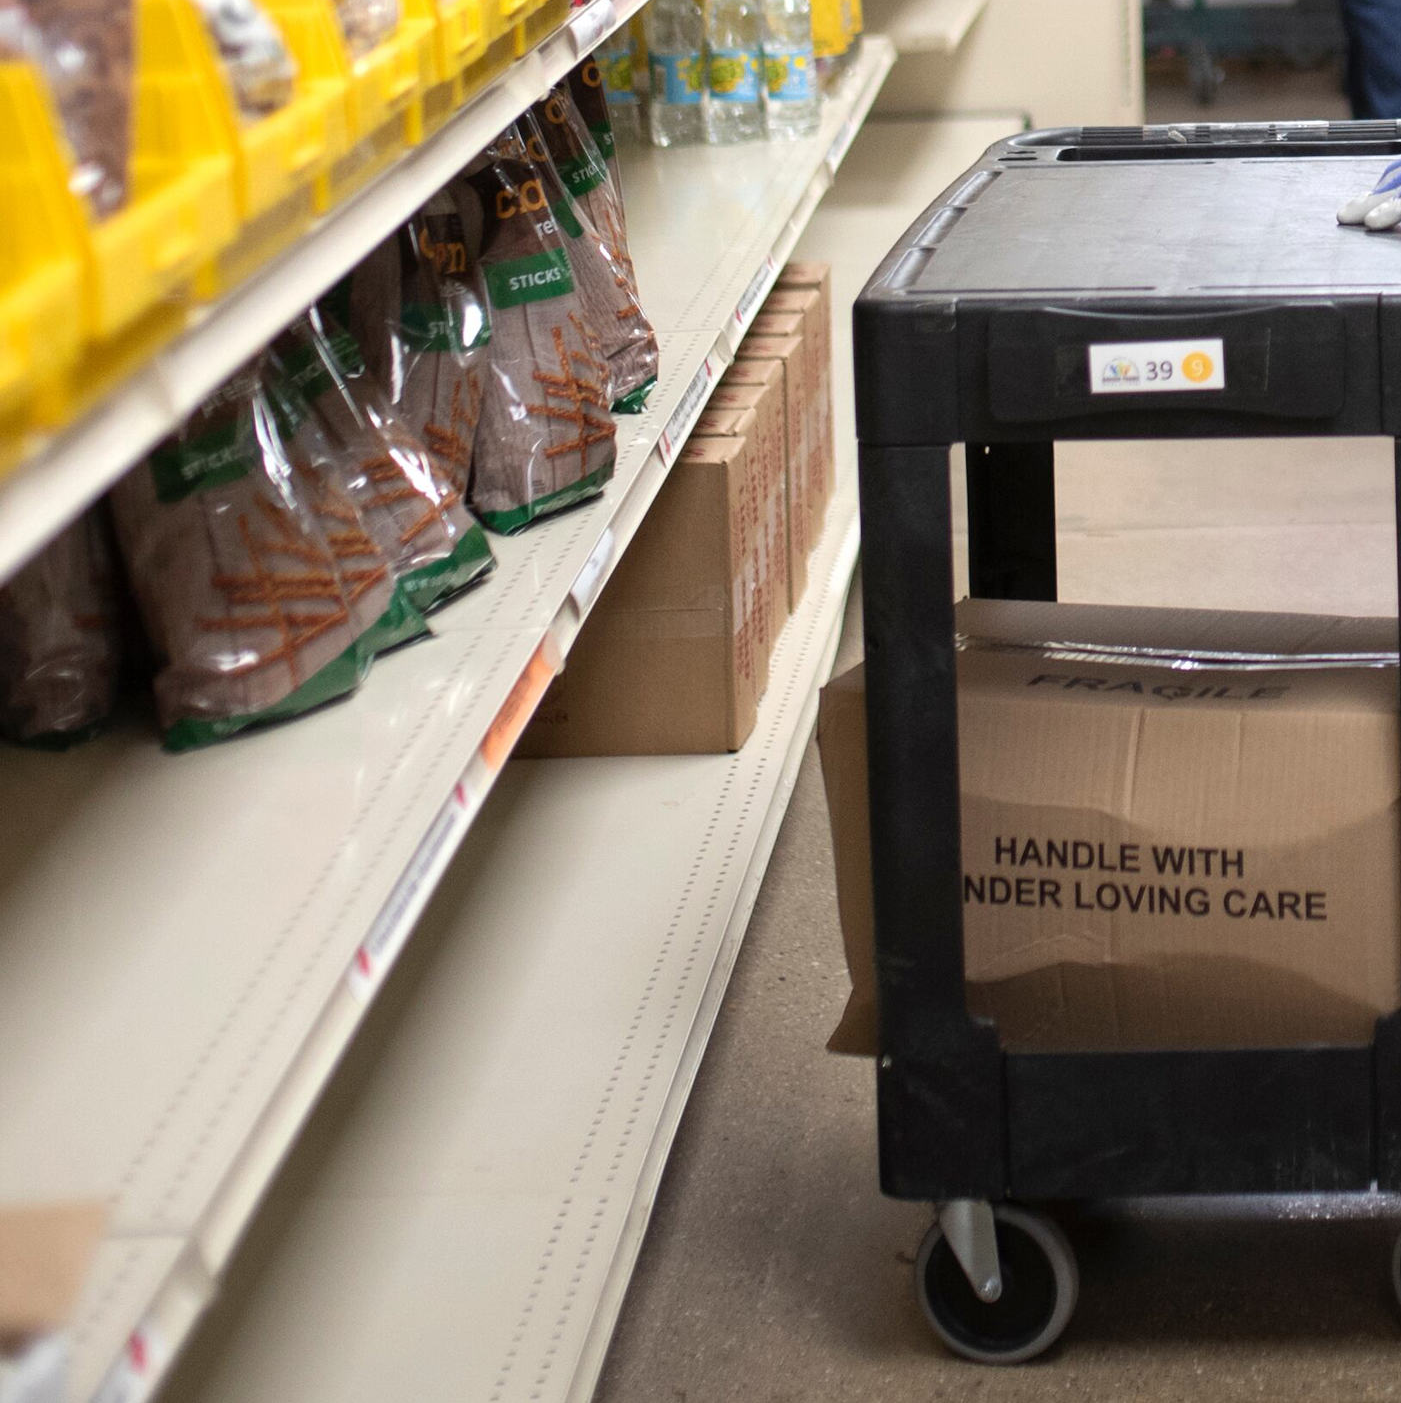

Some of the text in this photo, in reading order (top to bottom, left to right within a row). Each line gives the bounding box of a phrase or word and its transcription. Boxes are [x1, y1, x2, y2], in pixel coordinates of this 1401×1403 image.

[508, 266, 562, 291] STICKS
[1146, 361, 1173, 381] 39
[1027, 674, 1291, 701] FRAGILE
[994, 836, 1244, 878] HANDLE WITH
[963, 874, 1328, 921] NDER LOVING CARE
